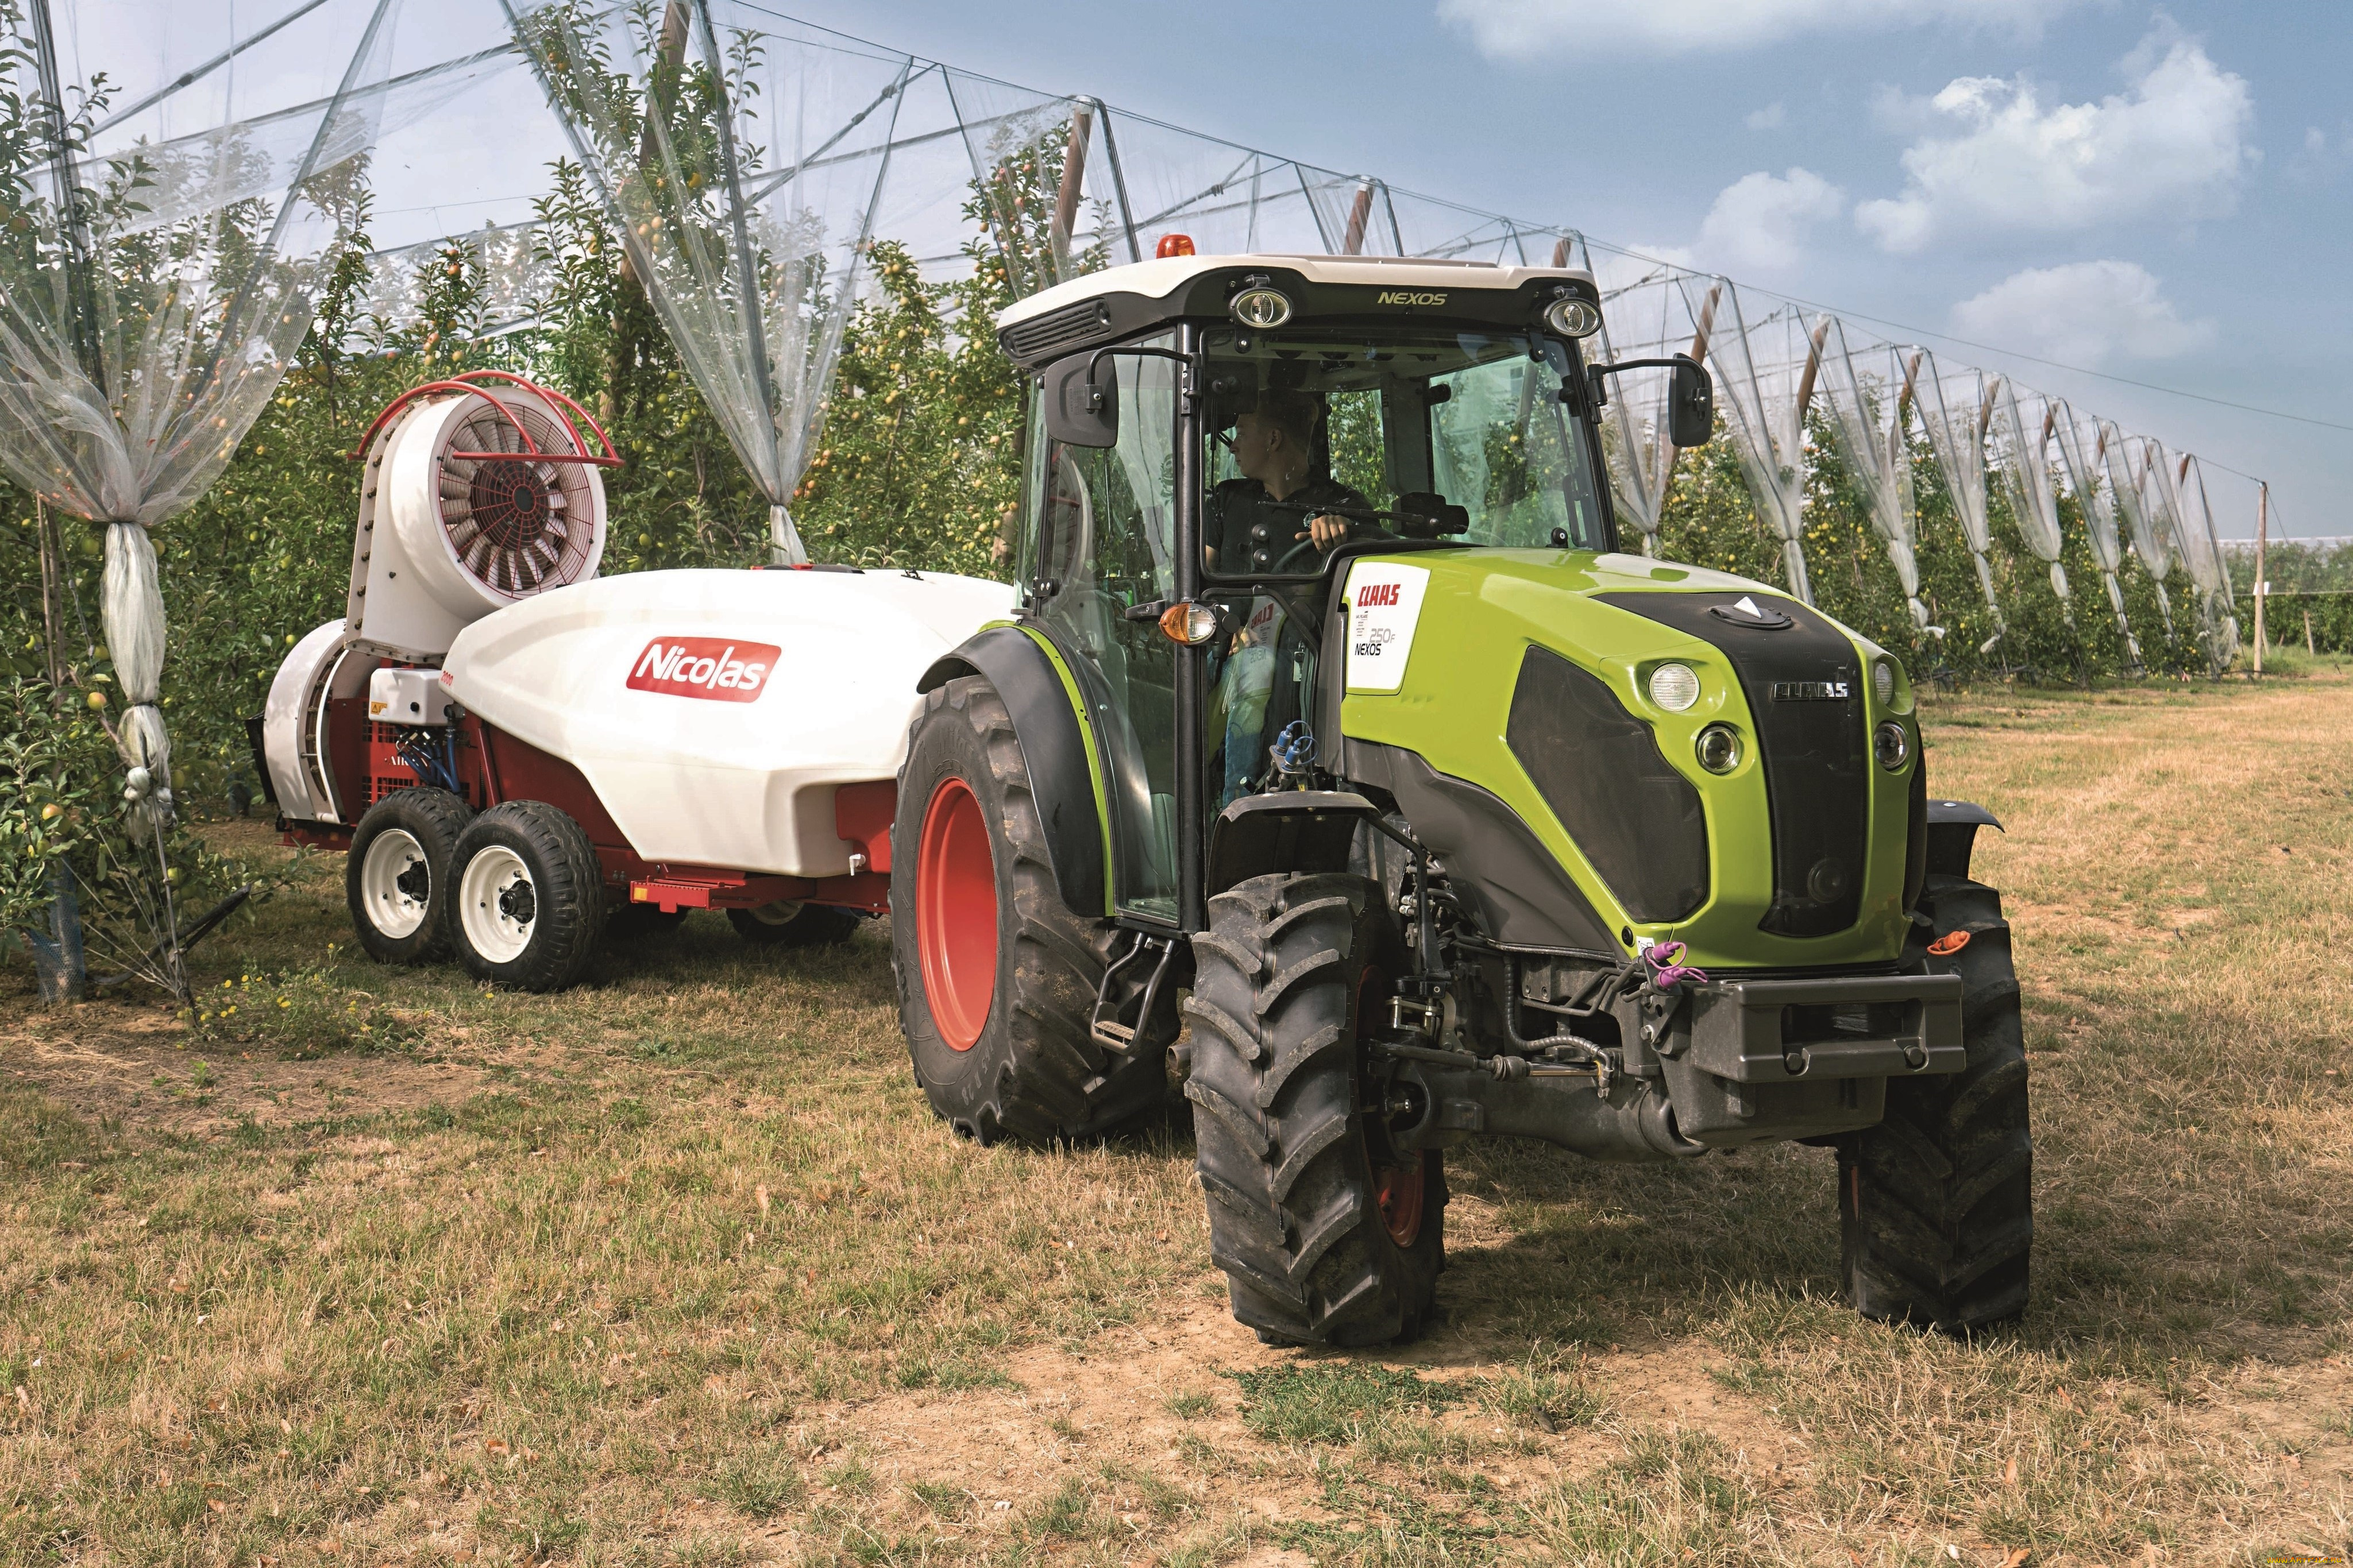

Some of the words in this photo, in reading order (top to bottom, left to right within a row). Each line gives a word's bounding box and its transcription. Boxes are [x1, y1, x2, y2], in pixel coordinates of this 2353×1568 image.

[1377, 292, 1448, 306] NEXOS
[1357, 584, 1401, 607] CLAAS
[1355, 643, 1382, 656] NEXOS
[635, 643, 766, 690] Nicolas
[1774, 682, 1849, 699] CLAAS
